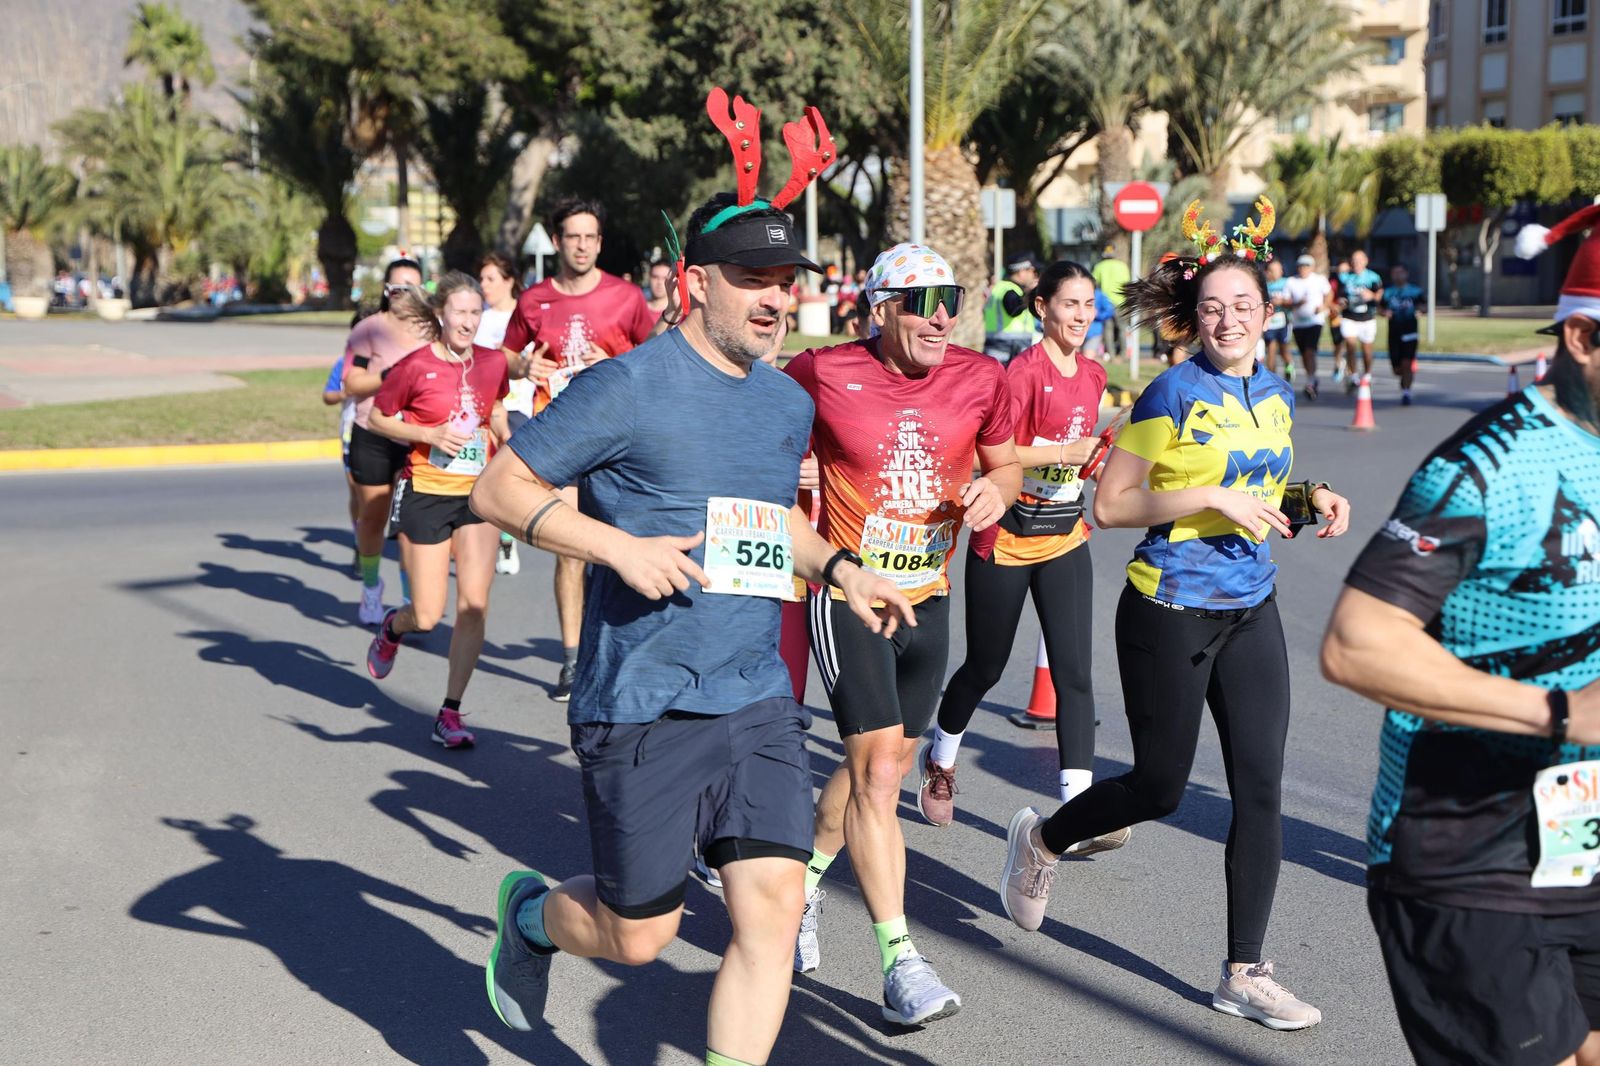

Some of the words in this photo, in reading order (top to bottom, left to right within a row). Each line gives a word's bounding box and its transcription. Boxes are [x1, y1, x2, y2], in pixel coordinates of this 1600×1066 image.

[899, 421, 917, 431] SAN
[893, 450, 926, 470] VES
[1041, 466, 1075, 483] 1378
[886, 470, 935, 500] TRE
[866, 525, 884, 538] SAN
[868, 538, 894, 550] CARRERA
[895, 543, 917, 553] URBANA
[736, 540, 784, 570] 526
[878, 551, 935, 571] 1084
